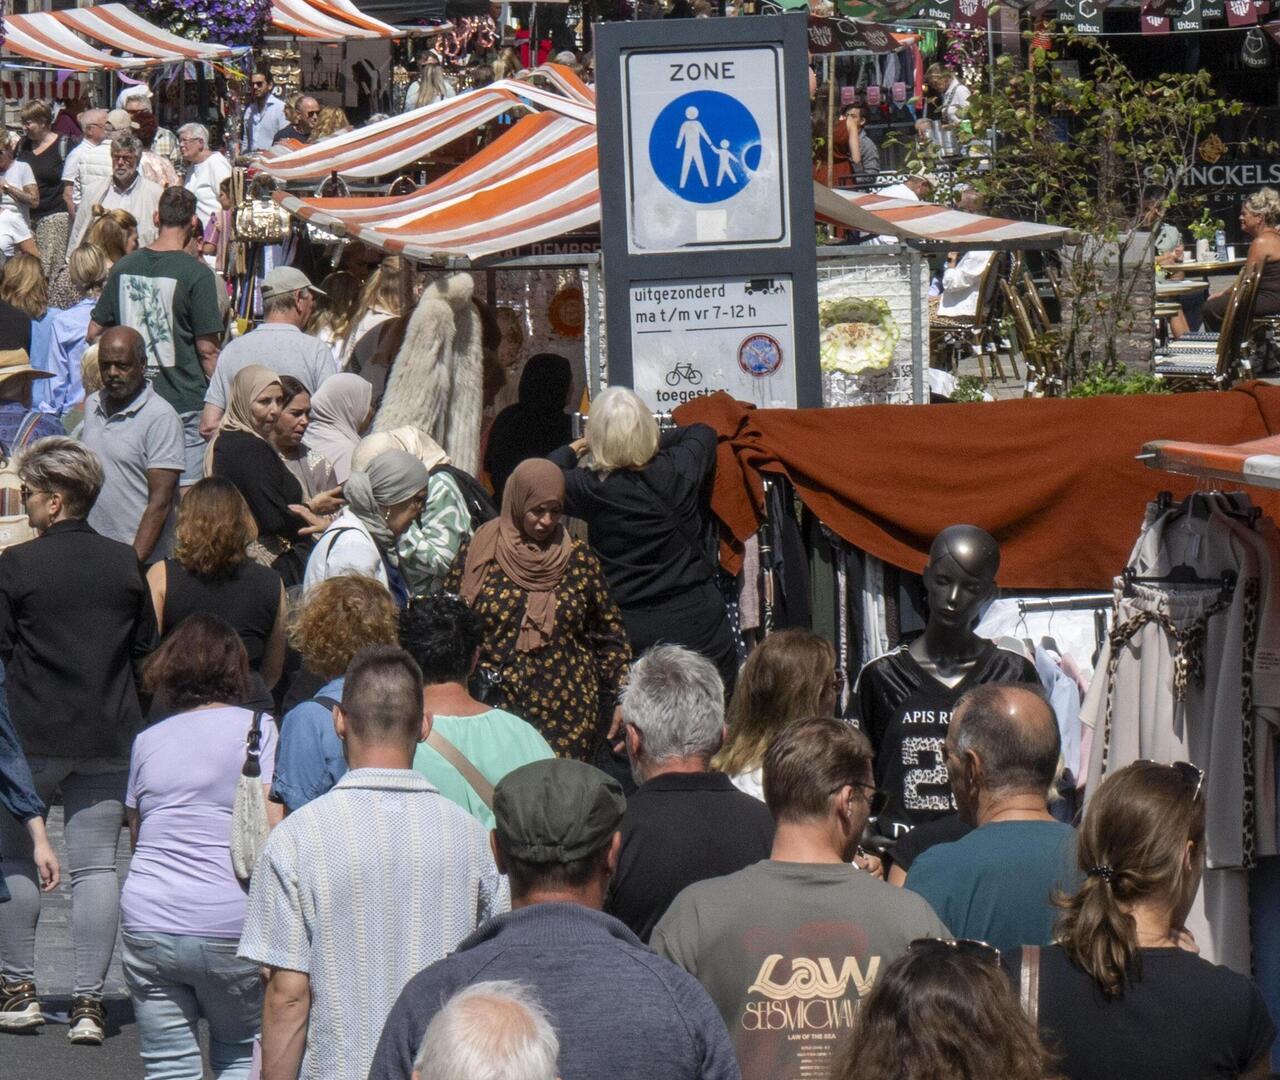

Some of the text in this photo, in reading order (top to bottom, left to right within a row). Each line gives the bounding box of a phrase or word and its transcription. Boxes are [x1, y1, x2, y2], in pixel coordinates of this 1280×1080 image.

[1078, 23, 1100, 33] thbx;
[1177, 21, 1199, 30] thbx;
[669, 61, 736, 82] ZONE
[634, 284, 726, 304] uitgezonderd
[636, 312, 656, 323] ma
[694, 308, 709, 320] vr
[713, 304, 745, 319] 7-12
[748, 304, 756, 318] h
[902, 711, 935, 724] APIS
